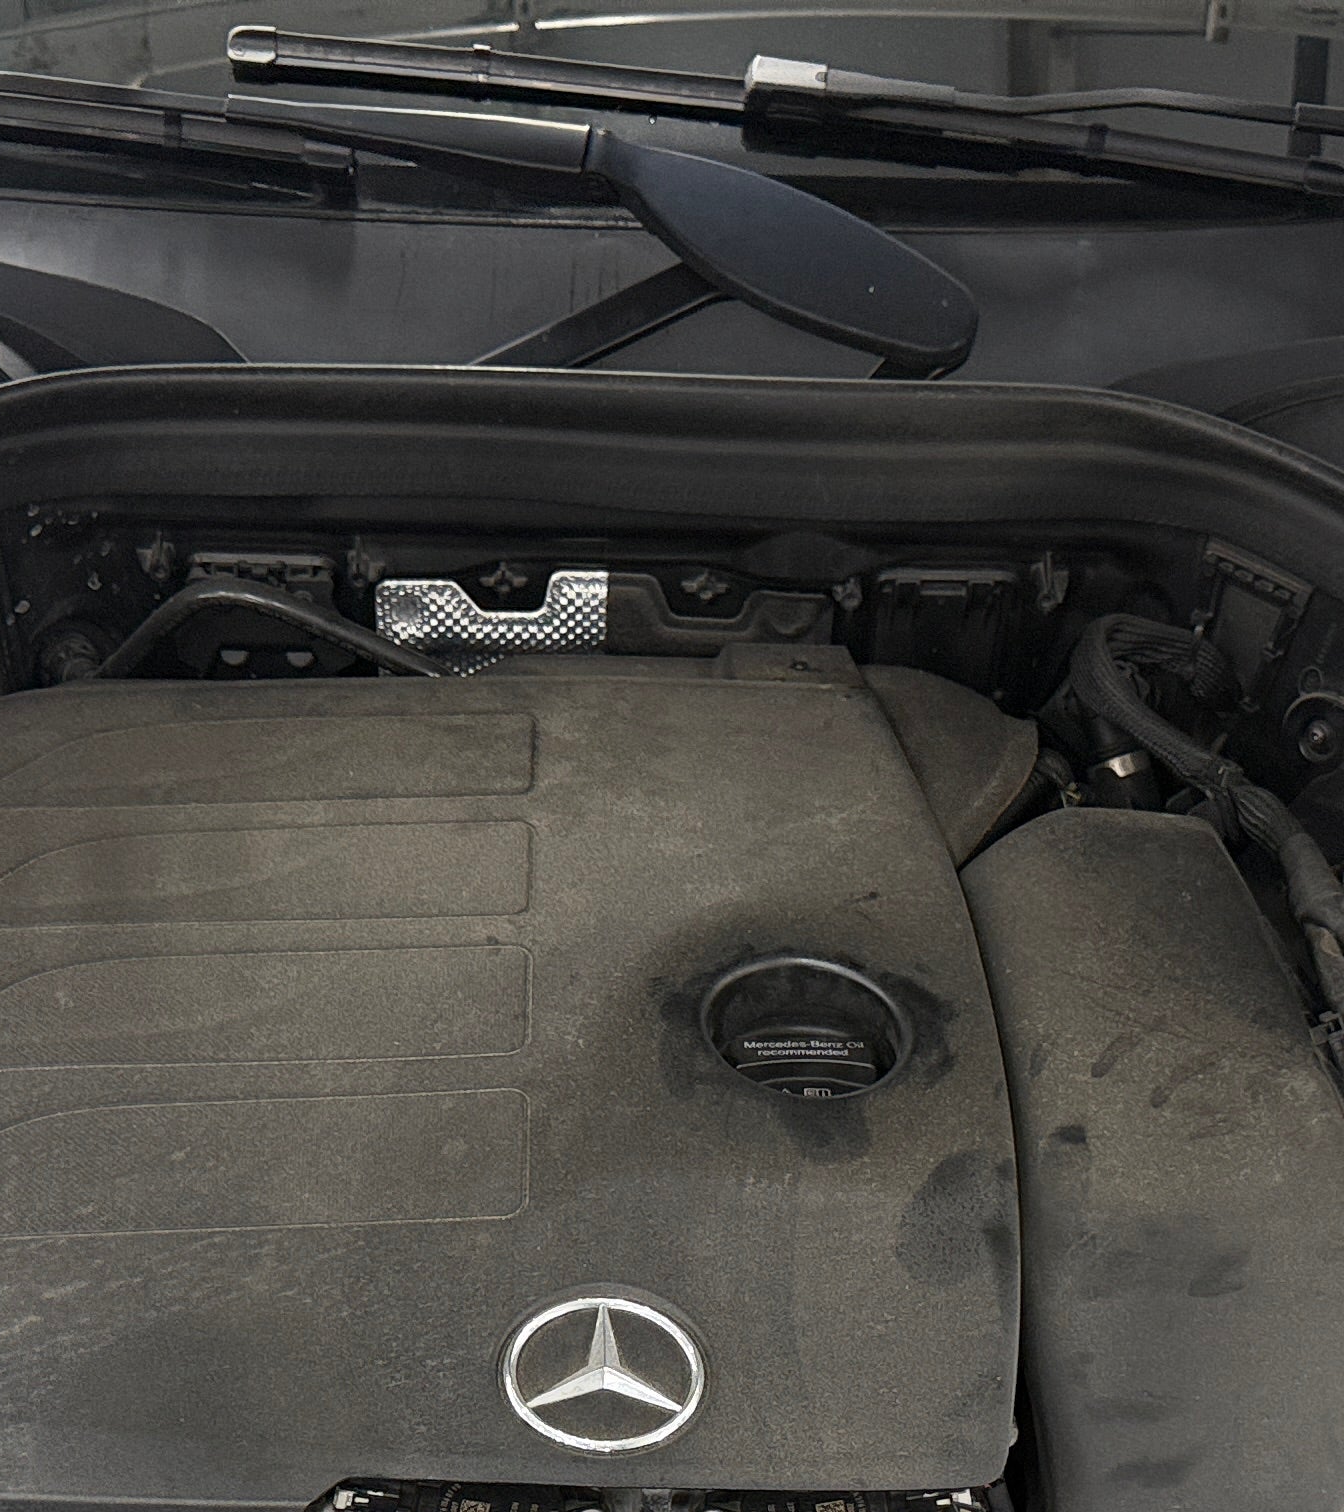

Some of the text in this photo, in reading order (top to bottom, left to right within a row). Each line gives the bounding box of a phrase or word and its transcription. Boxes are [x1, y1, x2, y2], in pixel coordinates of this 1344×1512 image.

[744, 1040, 864, 1049] Mercedes-Benz Oil
[758, 1048, 849, 1056] recommended
